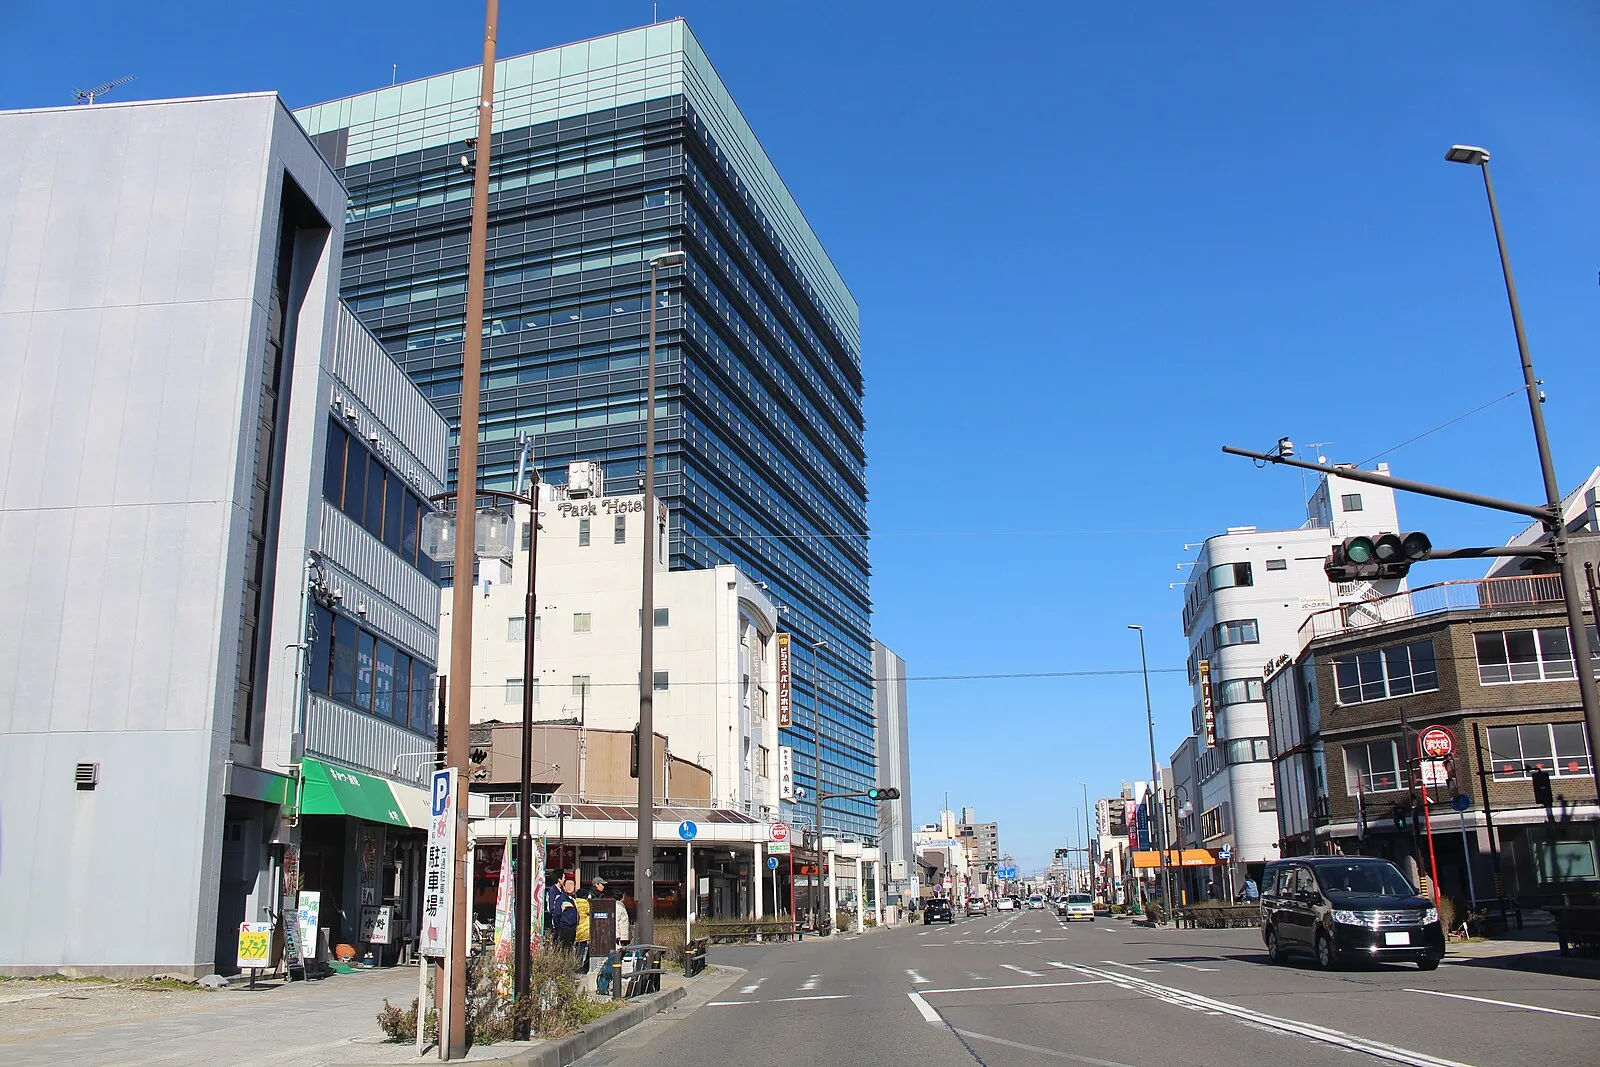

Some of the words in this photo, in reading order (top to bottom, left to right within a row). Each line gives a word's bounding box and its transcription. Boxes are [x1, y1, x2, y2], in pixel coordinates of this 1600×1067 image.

[557, 501, 598, 518] Park
[1426, 738, 1449, 750] 消火栓
[436, 777, 448, 812] P
[426, 846, 439, 917] 駐車場
[364, 918, 385, 930] 水野
